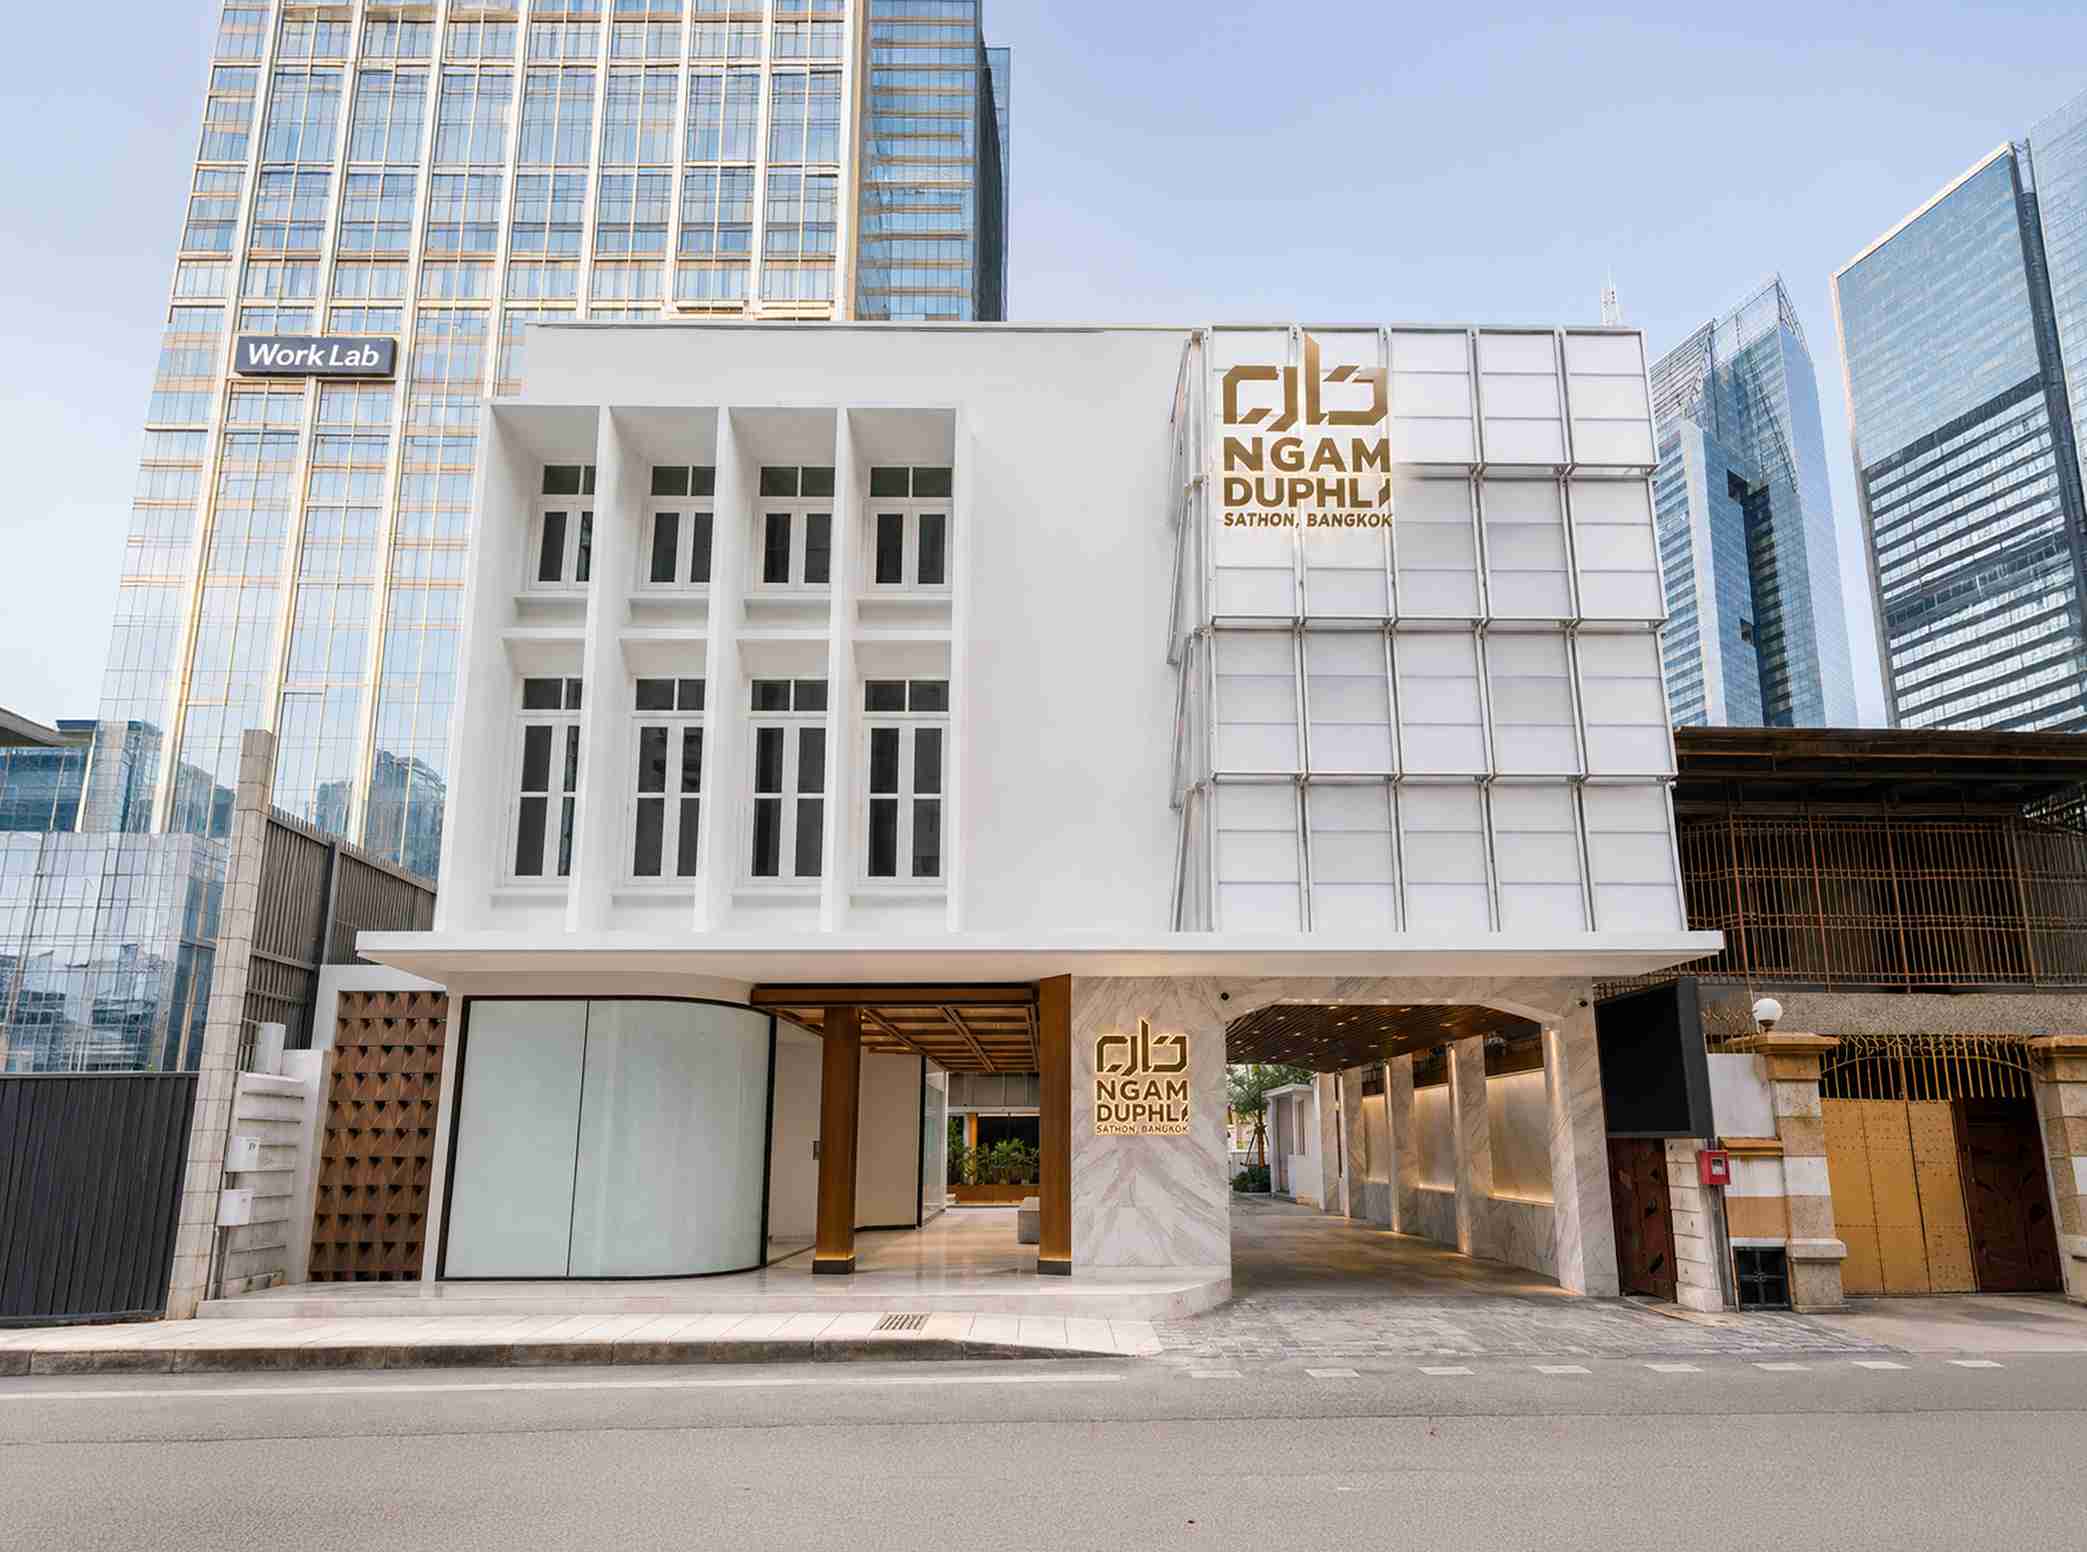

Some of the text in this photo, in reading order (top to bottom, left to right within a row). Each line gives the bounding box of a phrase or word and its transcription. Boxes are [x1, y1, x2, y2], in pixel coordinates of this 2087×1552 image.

[249, 343, 379, 366] Work Lab
[1223, 437, 1390, 472] NGAM
[1223, 512, 1392, 528] SATHON, BANGKOK
[1096, 1080, 1188, 1101] NGAM
